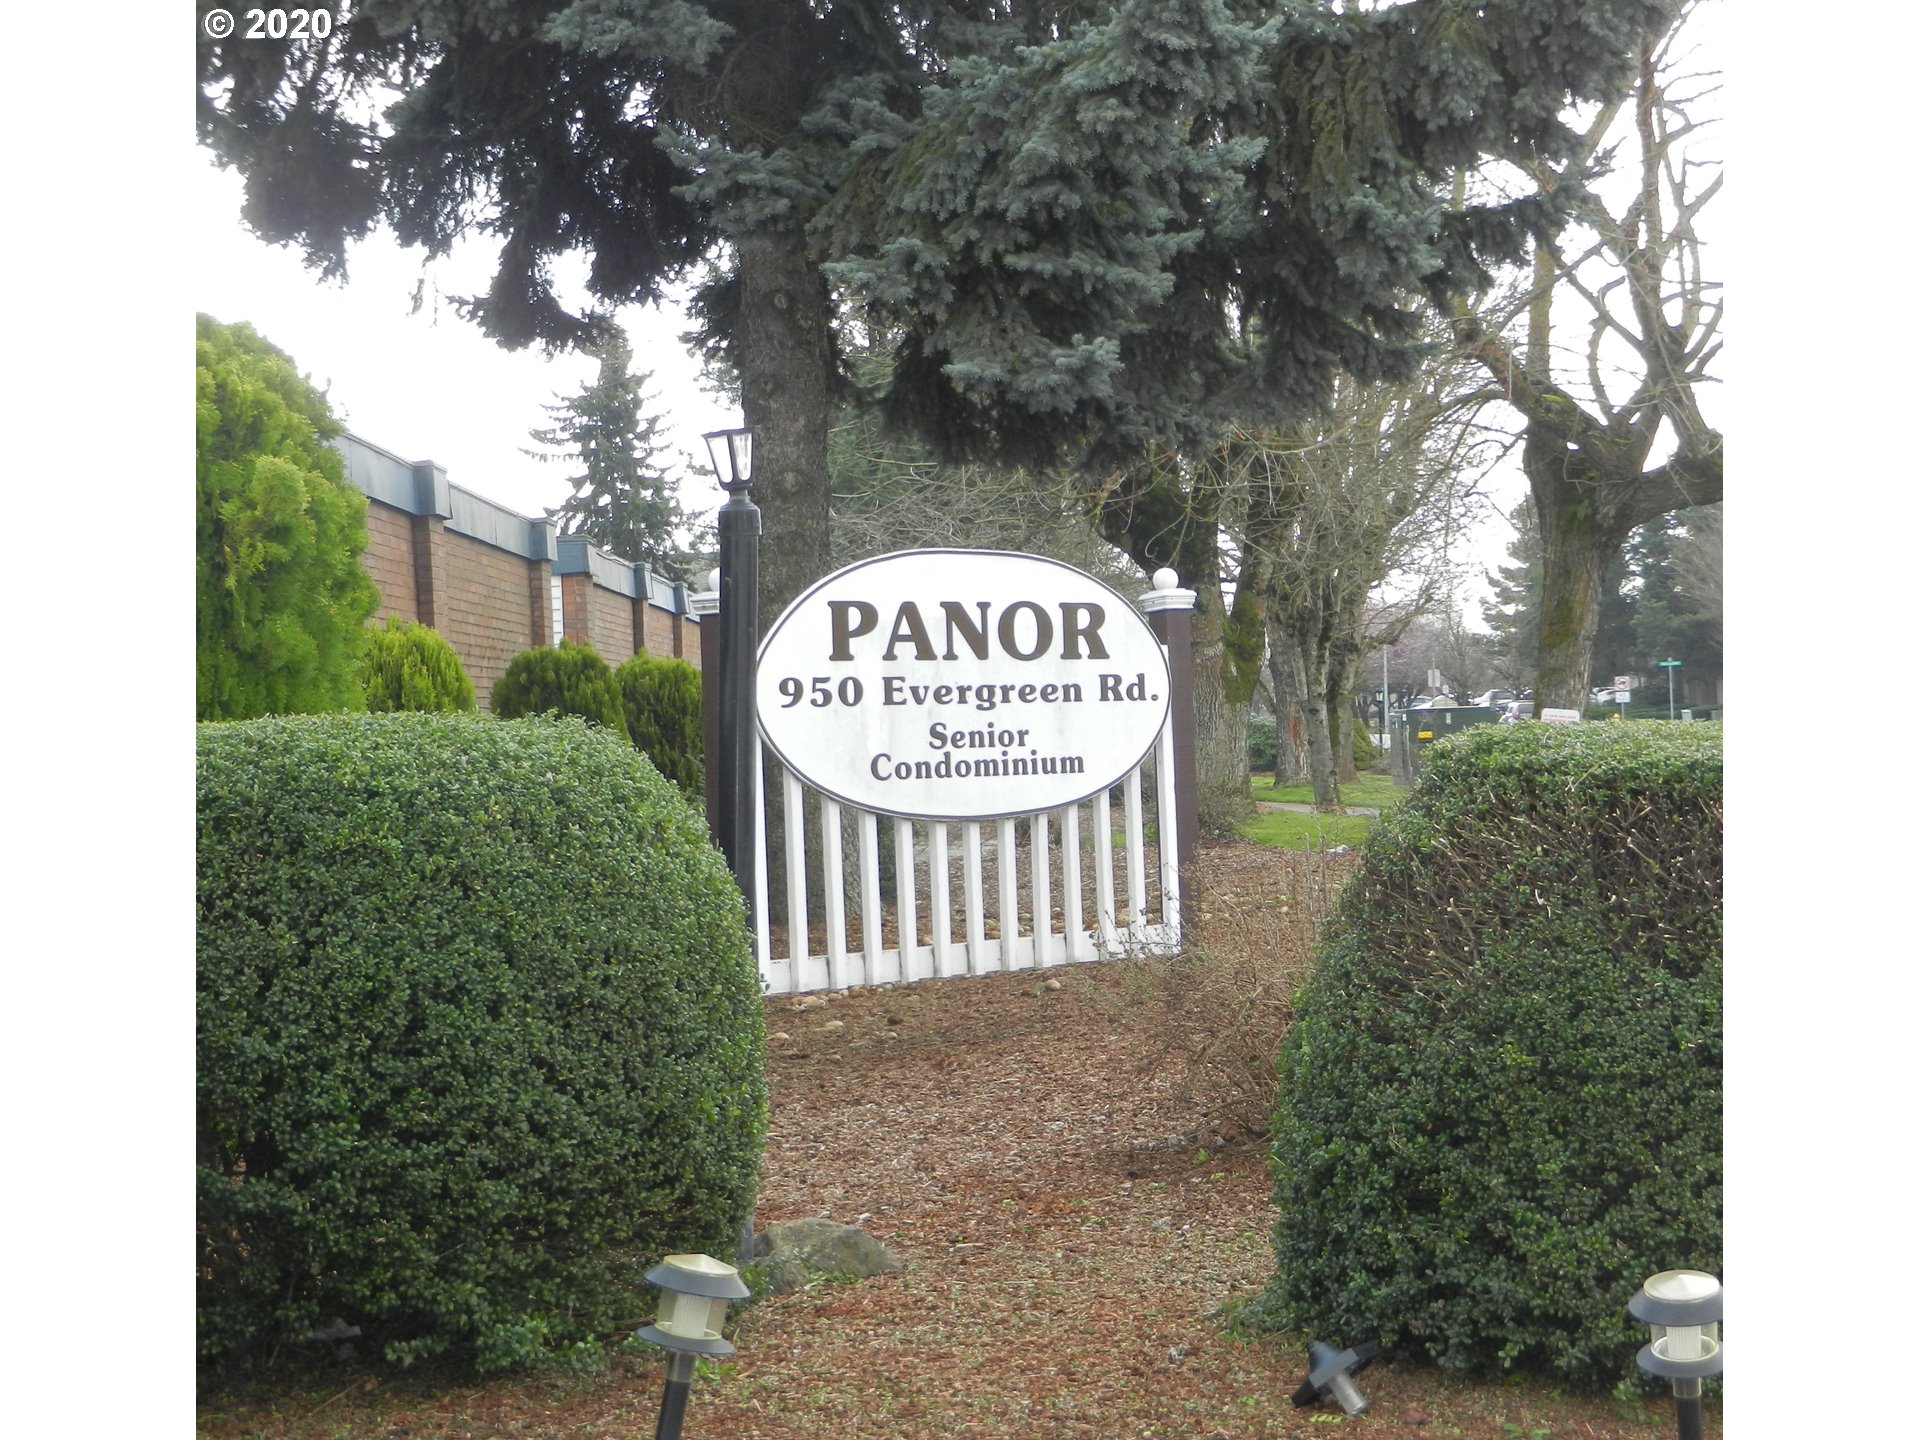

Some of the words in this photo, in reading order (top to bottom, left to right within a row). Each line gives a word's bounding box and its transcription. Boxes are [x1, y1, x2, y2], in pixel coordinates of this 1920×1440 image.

[828, 600, 1110, 662] PANOR
[778, 676, 864, 709] 950
[882, 676, 1083, 711] Evergreen
[1099, 673, 1159, 702] Rd.
[929, 722, 1029, 750] Senior
[870, 749, 1085, 782] Condominium
